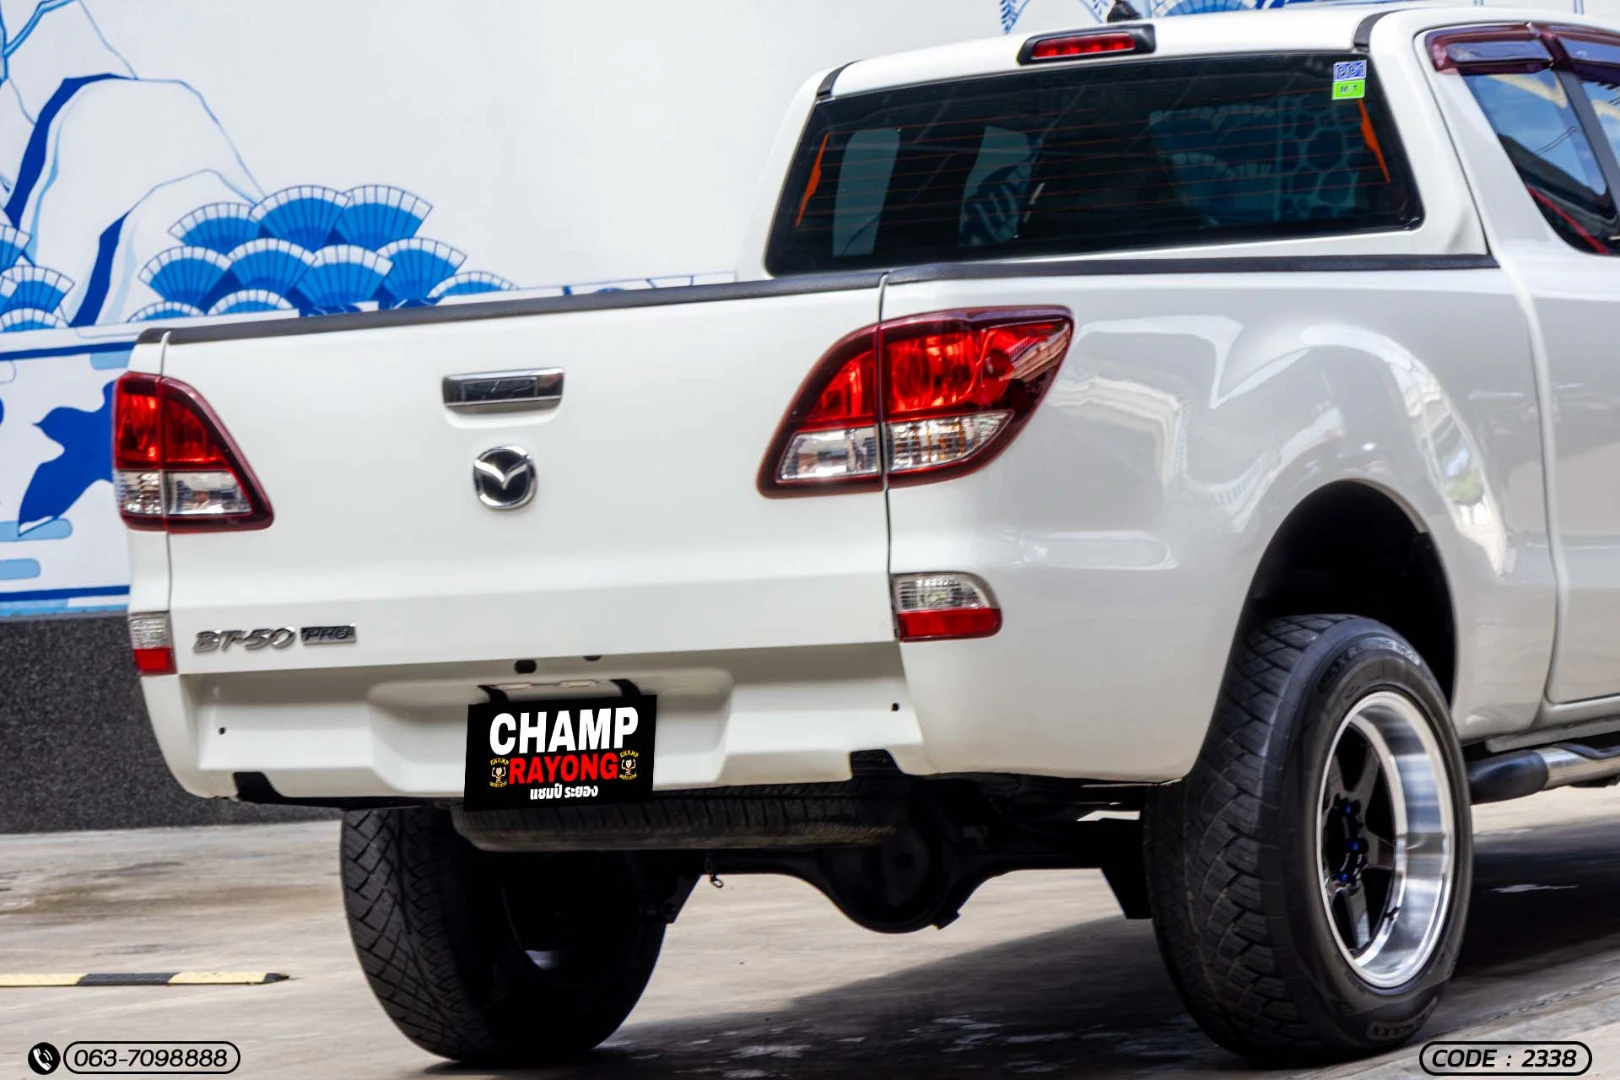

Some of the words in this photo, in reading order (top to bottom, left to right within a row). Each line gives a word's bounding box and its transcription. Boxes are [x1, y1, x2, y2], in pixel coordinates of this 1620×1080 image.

[193, 628, 296, 653] BT-50
[302, 625, 354, 644] PRO
[489, 706, 639, 755] CHAMP
[508, 752, 618, 785] RAYONG
